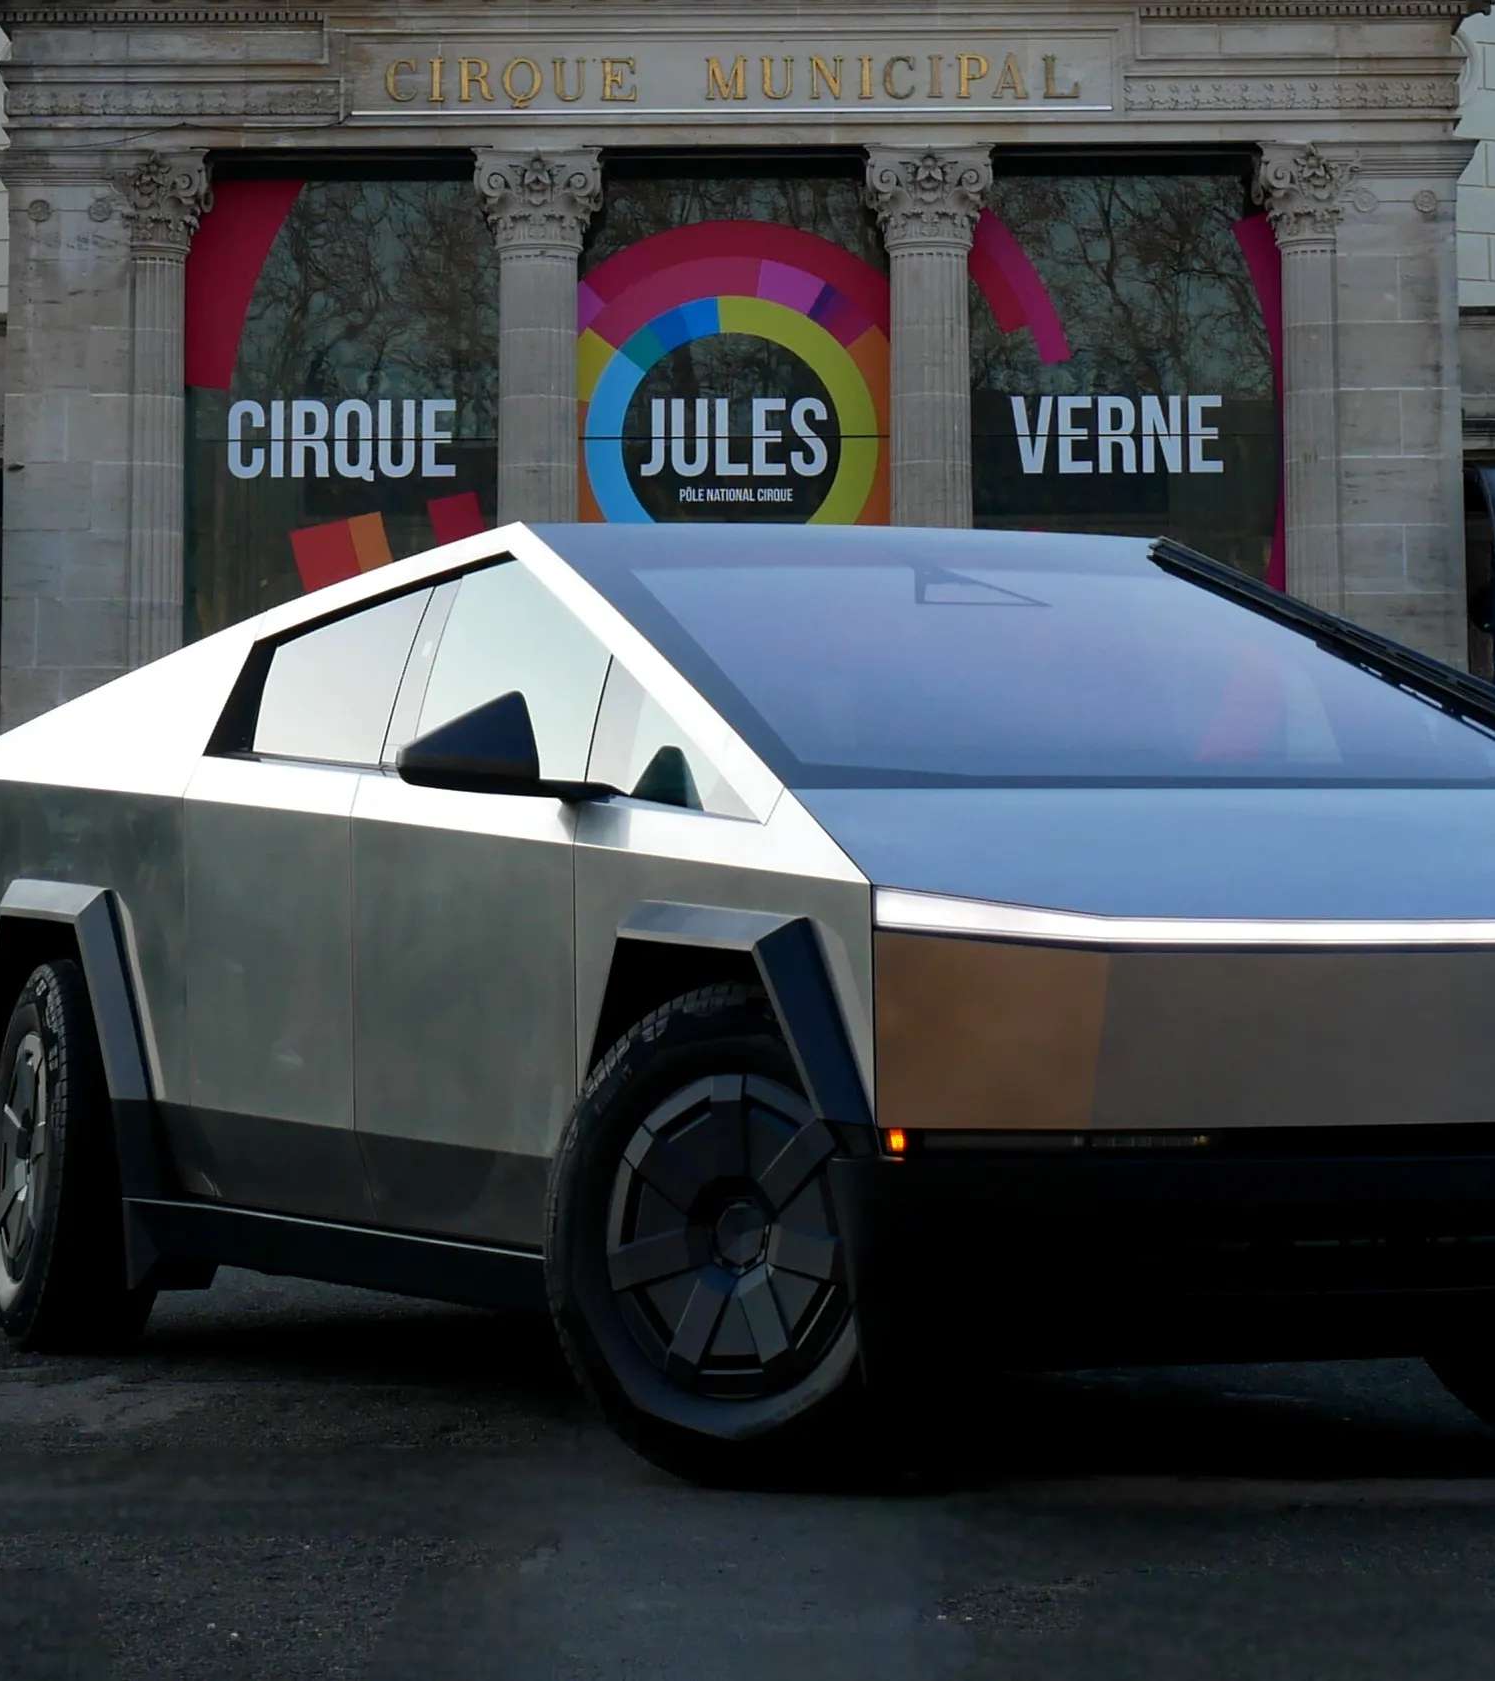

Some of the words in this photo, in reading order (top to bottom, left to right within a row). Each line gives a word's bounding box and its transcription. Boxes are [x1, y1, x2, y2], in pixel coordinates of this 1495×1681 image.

[385, 57, 638, 109] CIRQUE
[706, 52, 1080, 100] MUNICIPAL
[227, 399, 457, 482] CIRQUE
[640, 397, 828, 477] JULES
[1010, 395, 1224, 474] VERNE
[679, 486, 705, 502] PÔLE
[706, 488, 756, 502] NATIONAL
[757, 488, 794, 502] CIRQUE
